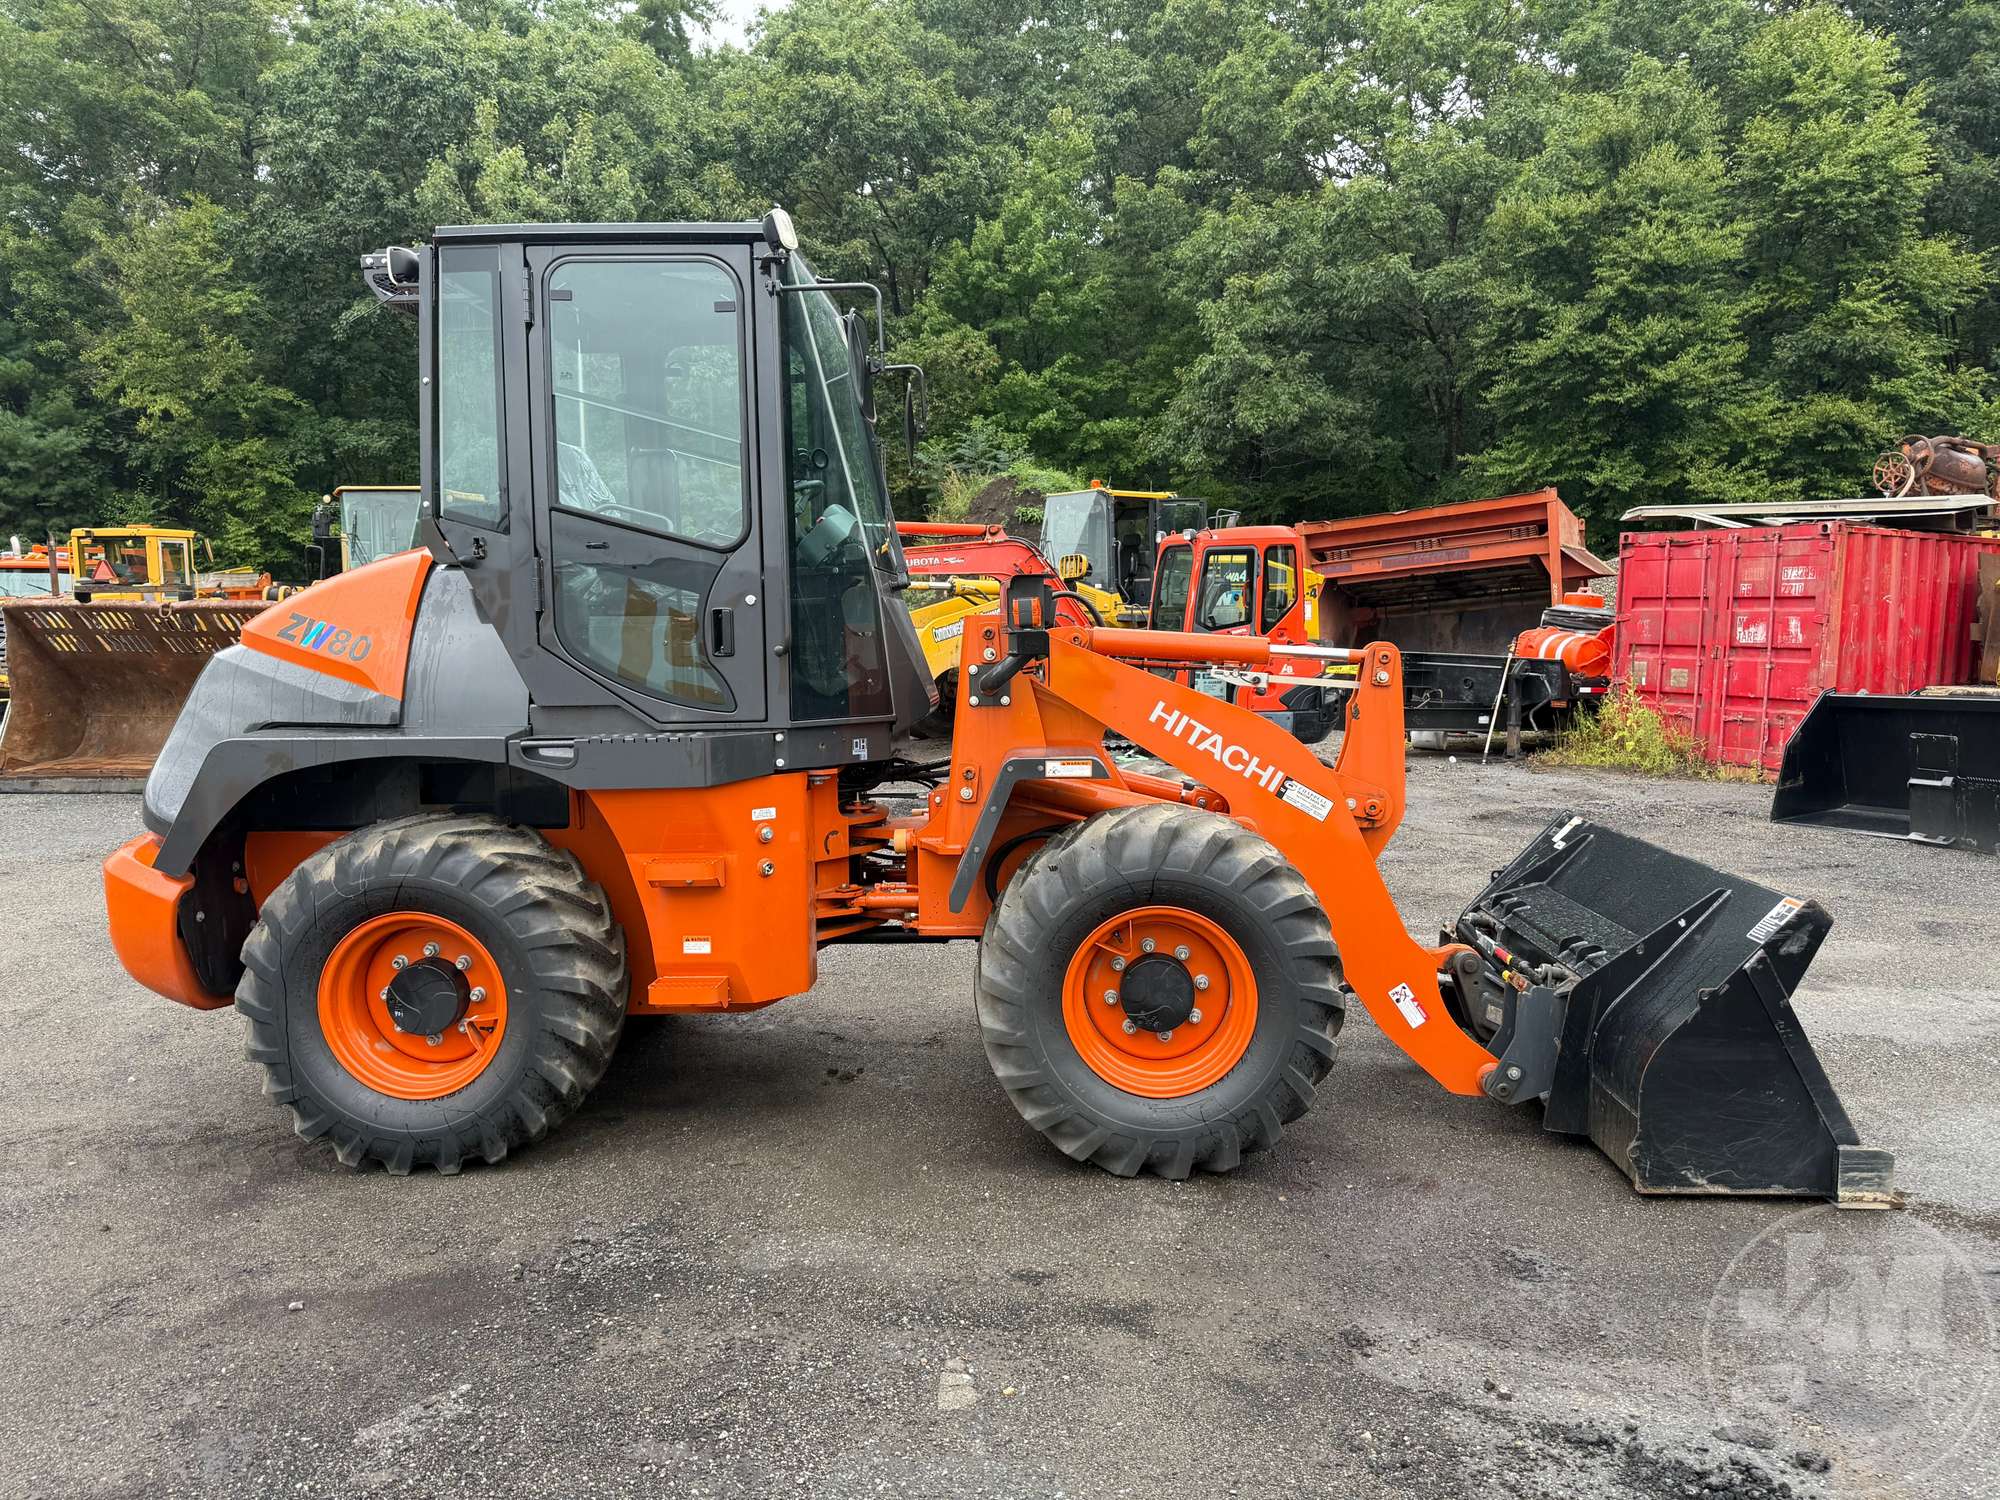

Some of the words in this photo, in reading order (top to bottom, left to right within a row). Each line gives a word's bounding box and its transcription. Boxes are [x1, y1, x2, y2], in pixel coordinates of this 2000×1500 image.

[905, 557, 941, 567] UBOTA
[277, 612, 372, 661] ZW80
[1149, 700, 1284, 793] HITACHI
